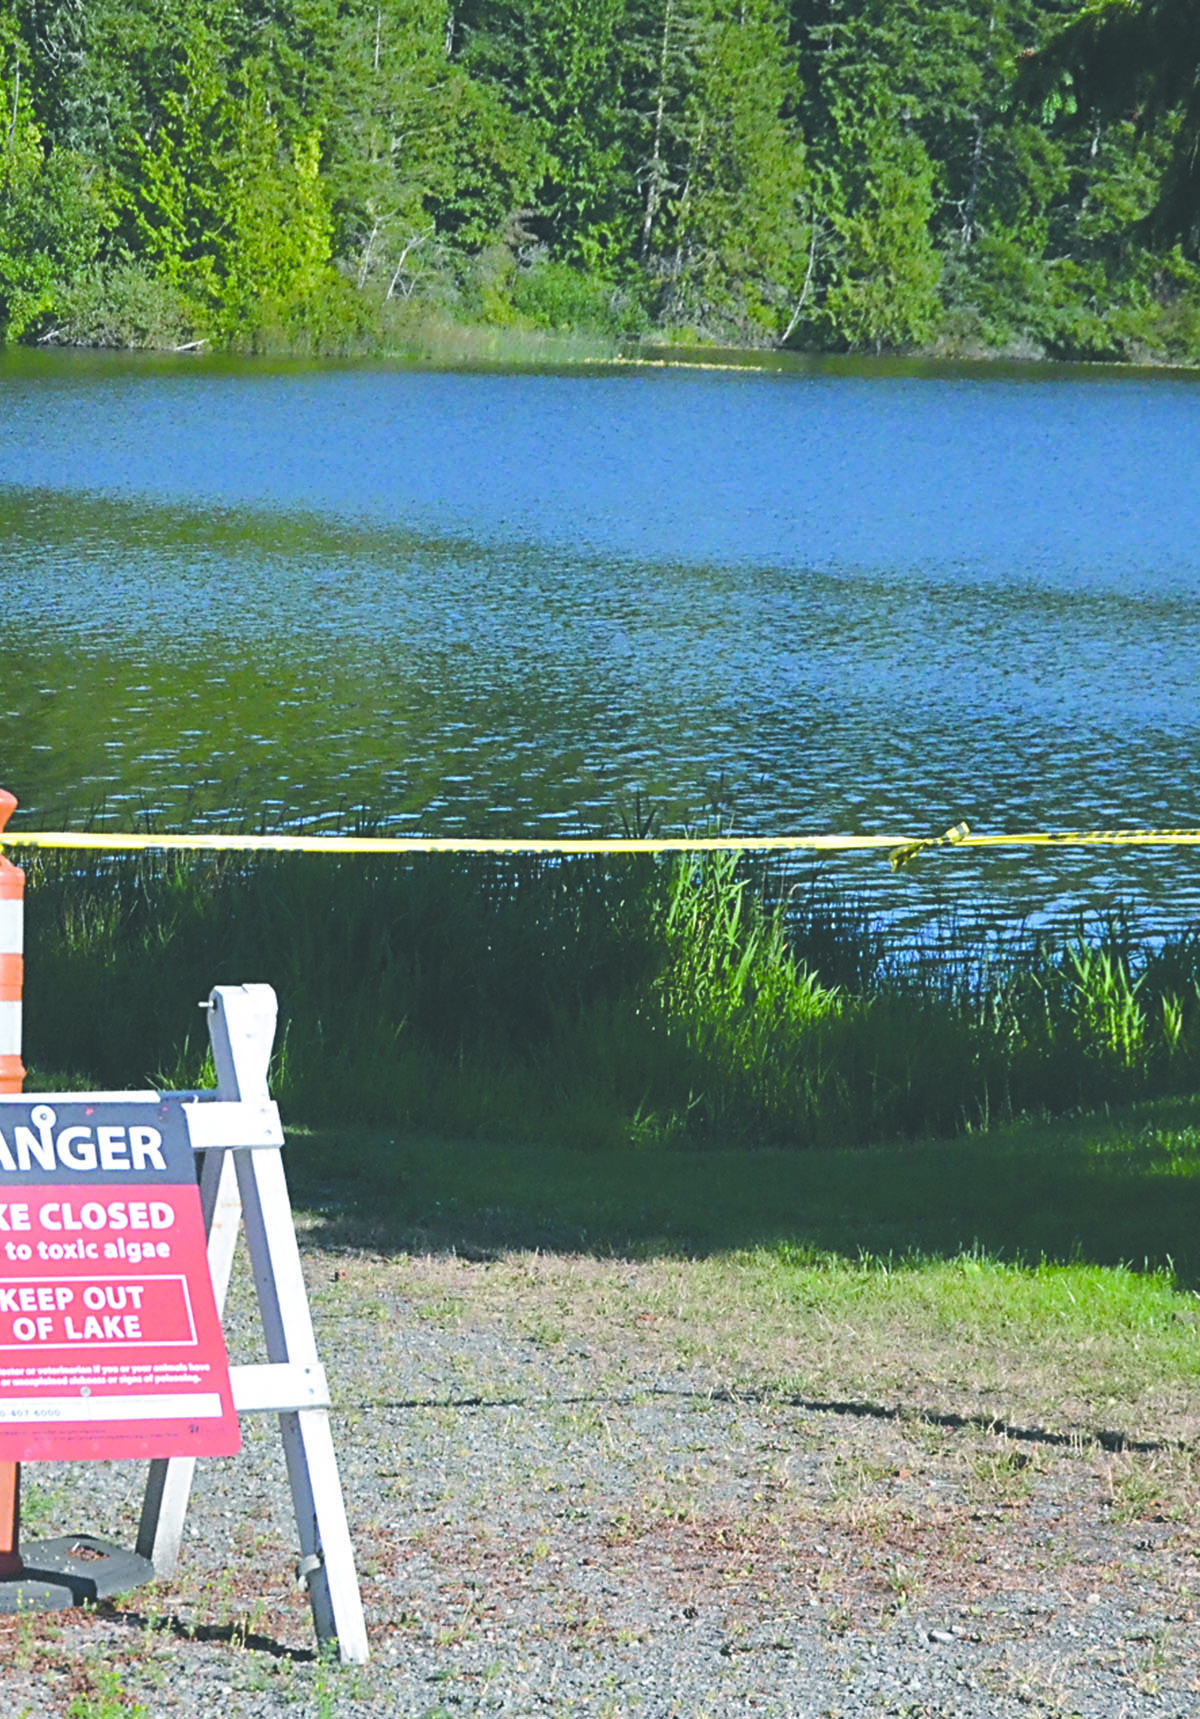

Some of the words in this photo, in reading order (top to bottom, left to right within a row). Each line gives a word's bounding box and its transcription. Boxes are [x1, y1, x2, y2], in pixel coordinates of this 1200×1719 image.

[39, 1201, 175, 1231] CLOSED
[4, 1241, 32, 1261] to
[36, 1238, 99, 1260] toxic
[103, 1237, 171, 1263] algae
[83, 1285, 144, 1310] OUT
[12, 1316, 54, 1341] OF
[64, 1315, 142, 1340] LAKE
